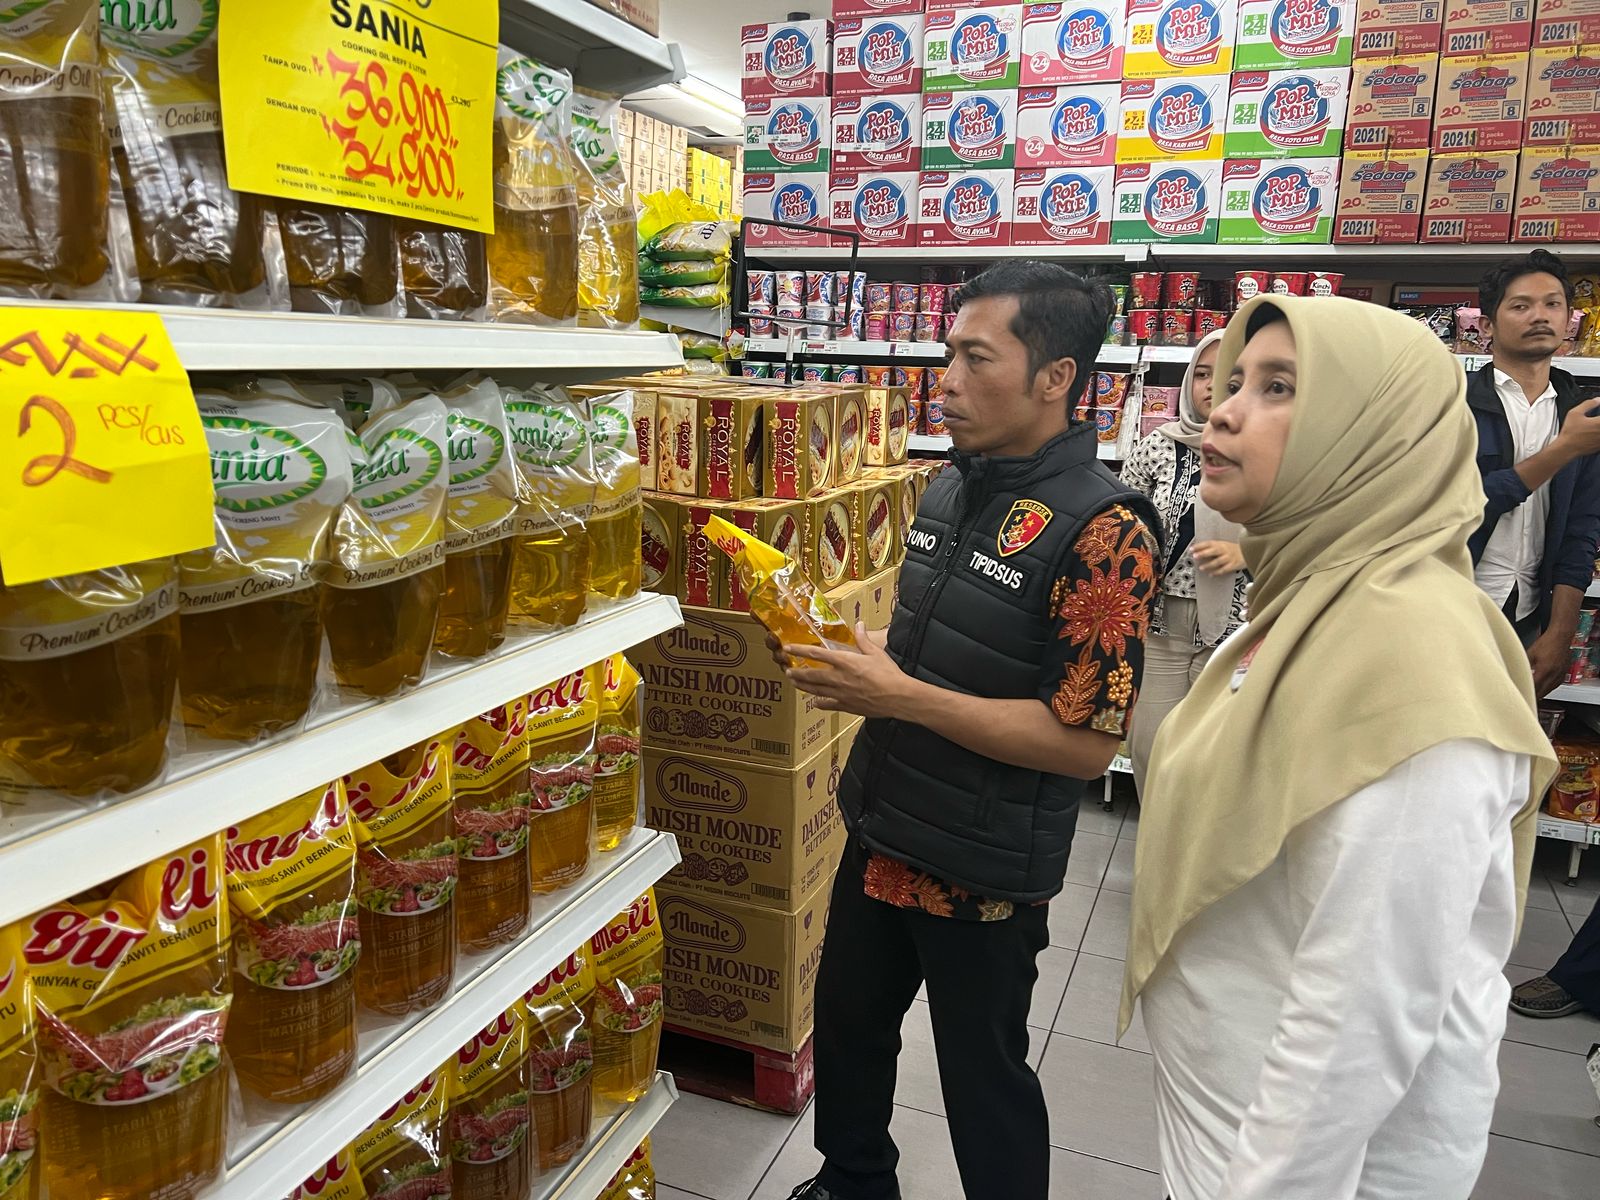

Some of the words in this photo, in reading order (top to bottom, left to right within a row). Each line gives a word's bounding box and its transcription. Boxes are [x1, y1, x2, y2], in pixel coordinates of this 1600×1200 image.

[1170, 5, 1202, 28] POP
[1284, 0, 1317, 17] POP
[1425, 8, 1433, 18] 8
[1515, 7, 1524, 17] 8
[330, 0, 427, 59] SANIA
[1068, 17, 1095, 36] POP
[1174, 17, 1209, 41] MIE
[1289, 14, 1326, 30] MIE
[1542, 22, 1579, 41] 20211
[868, 31, 894, 50] POP
[961, 23, 989, 44] POP
[1072, 28, 1102, 47] MIE
[1361, 33, 1395, 49] 20211
[1451, 33, 1485, 51] 20211
[342, 40, 377, 56] COOKING
[379, 52, 390, 60] OIL
[773, 35, 799, 57] POP
[873, 42, 901, 62] MIE
[966, 35, 996, 56] MIE
[263, 55, 289, 67] TANPA
[291, 63, 307, 72] OVO
[777, 47, 806, 68] MIE
[69, 65, 92, 89] Oil
[1362, 72, 1428, 87] Sedaap
[1450, 75, 1518, 90] Sedaap
[1161, 94, 1194, 115] POP
[1275, 85, 1310, 105] POP
[1529, 98, 1552, 111] 20
[266, 98, 298, 111] DENGAN
[300, 106, 316, 115] OVO
[960, 105, 988, 125] POP
[1062, 104, 1090, 124] POP
[1279, 102, 1315, 120] MIE
[1353, 103, 1373, 115] 20
[1417, 104, 1425, 114] 8
[1440, 105, 1461, 118] 20
[1507, 107, 1516, 117] 8
[777, 111, 802, 128] POP
[868, 109, 894, 128] POP
[1067, 116, 1095, 134] MIE
[1166, 107, 1199, 126] MIE
[871, 122, 900, 140] MIE
[964, 118, 994, 137] MIE
[1353, 127, 1387, 143] 20211
[1442, 130, 1476, 147] 20211
[777, 152, 794, 160] RASA
[958, 148, 976, 156] RASA
[978, 148, 998, 157] BASO
[1351, 169, 1418, 182] Sedaap
[1438, 168, 1508, 181] Sedaap
[1530, 167, 1599, 181] Sedaap
[955, 184, 982, 203] POP
[1052, 182, 1080, 200] POP
[1156, 177, 1188, 198] POP
[1266, 174, 1299, 195] POP
[781, 190, 804, 207] POP
[863, 186, 890, 206] POP
[959, 196, 988, 215] MIE
[1056, 195, 1087, 213] MIE
[1160, 189, 1194, 210] MIE
[1270, 188, 1311, 209] MIE
[1341, 198, 1362, 209] 20
[1404, 200, 1413, 209] 8
[1428, 198, 1450, 209] 20
[1495, 200, 1504, 210] 8
[1520, 195, 1542, 209] 20
[1588, 199, 1596, 209] 8
[785, 202, 808, 216] MIE
[868, 198, 896, 217] MIE
[864, 228, 880, 236] RASA
[880, 228, 899, 237] AYAM
[953, 225, 971, 235] RASA
[972, 227, 991, 235] AYAM
[1068, 226, 1089, 235] AYAM
[1154, 221, 1175, 231] RASA
[1176, 222, 1198, 231] BASO
[1342, 220, 1374, 236] 20211
[1429, 219, 1463, 237] 20211
[1521, 220, 1556, 237] 20211
[872, 409, 880, 444] ROYAL
[18, 394, 114, 487] 2
[680, 423, 690, 465] ROYAL
[716, 416, 729, 482] ROYAL
[782, 417, 795, 482] ROYAL
[1018, 502, 1049, 516] RESERSE
[344, 563, 398, 584] Premium
[399, 551, 433, 574] Cooking
[969, 551, 1024, 589] TIPIDSUS
[178, 585, 237, 605] Premium
[20, 622, 102, 652] Premium
[105, 601, 157, 634] Cooking
[668, 627, 731, 657] Monde
[637, 662, 701, 691] ANISH
[705, 671, 782, 702] MONDE
[700, 695, 772, 718] COOKIES
[533, 718, 554, 731] SAWIT
[669, 771, 731, 804] Monde
[380, 809, 404, 829] SAWIT
[404, 782, 443, 812] BERMUTU
[650, 806, 702, 835] NISH
[706, 816, 782, 850] MONDE
[802, 797, 835, 845] DANISH
[700, 840, 772, 864] COOKIES
[805, 827, 831, 858] BUTTER
[278, 860, 305, 880] SAWIT
[160, 917, 218, 949] BERMUTU
[669, 910, 731, 943] Monde
[706, 954, 780, 990] MONDE
[32, 976, 79, 989] MINYAK
[700, 976, 770, 1003] COOKIES
[463, 1063, 486, 1085] SAWIT
